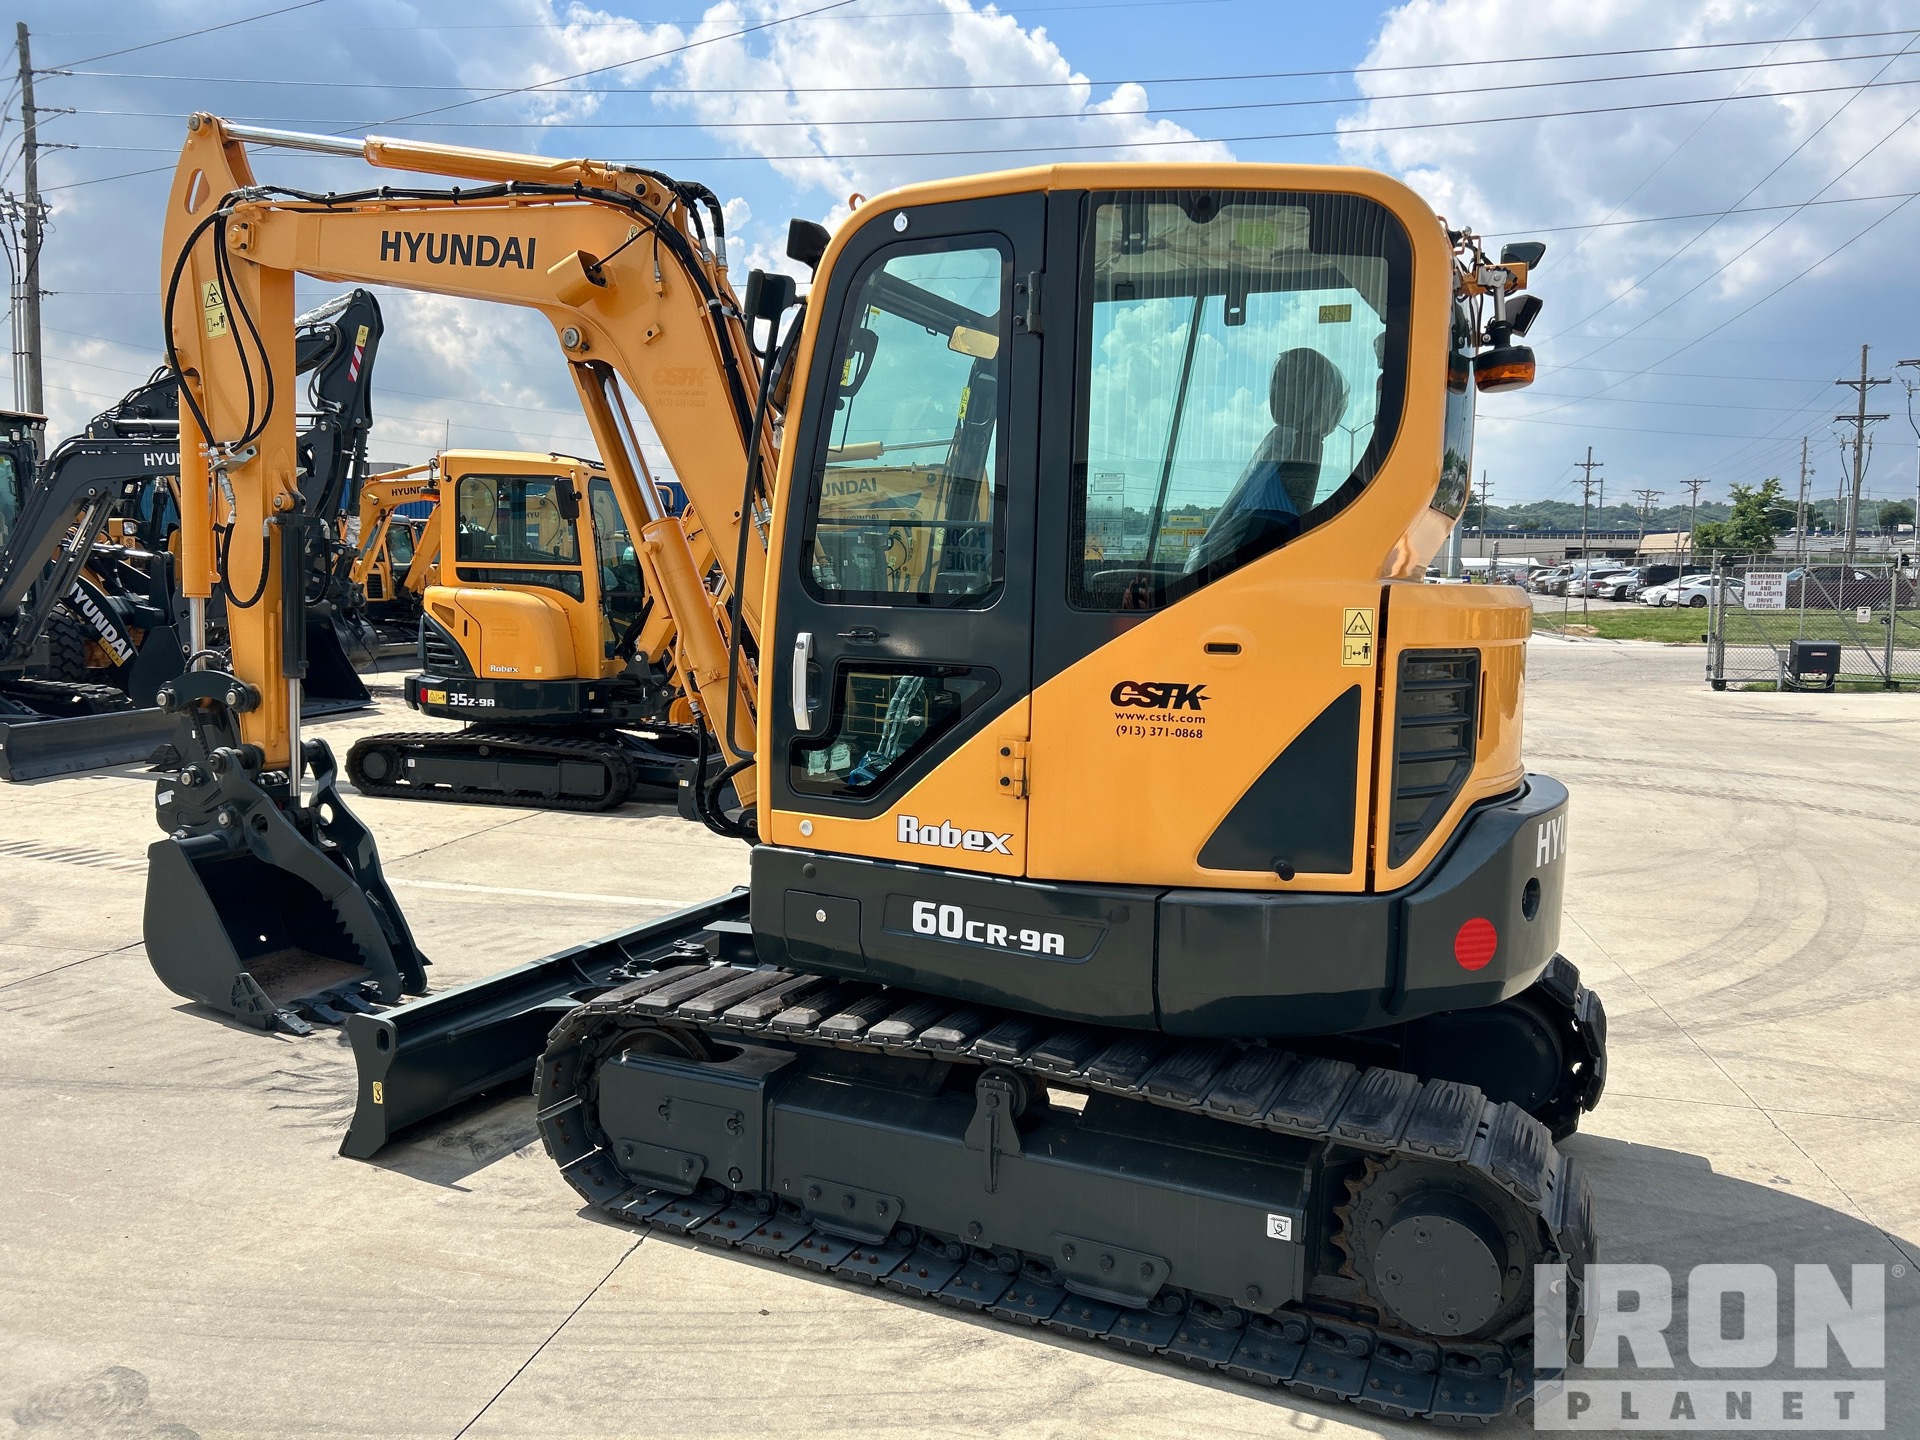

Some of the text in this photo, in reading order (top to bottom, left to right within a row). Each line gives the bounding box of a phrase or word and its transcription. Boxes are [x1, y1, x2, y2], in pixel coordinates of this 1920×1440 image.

[380, 230, 536, 270] HYUNDAI
[490, 664, 520, 674] Robex
[1110, 680, 1209, 711] CSTK
[1115, 712, 1206, 724] www.cstk.com
[1116, 725, 1203, 739] (913) 371-0868
[897, 813, 1014, 856] Robex
[912, 900, 1065, 956] 60CR-9A
